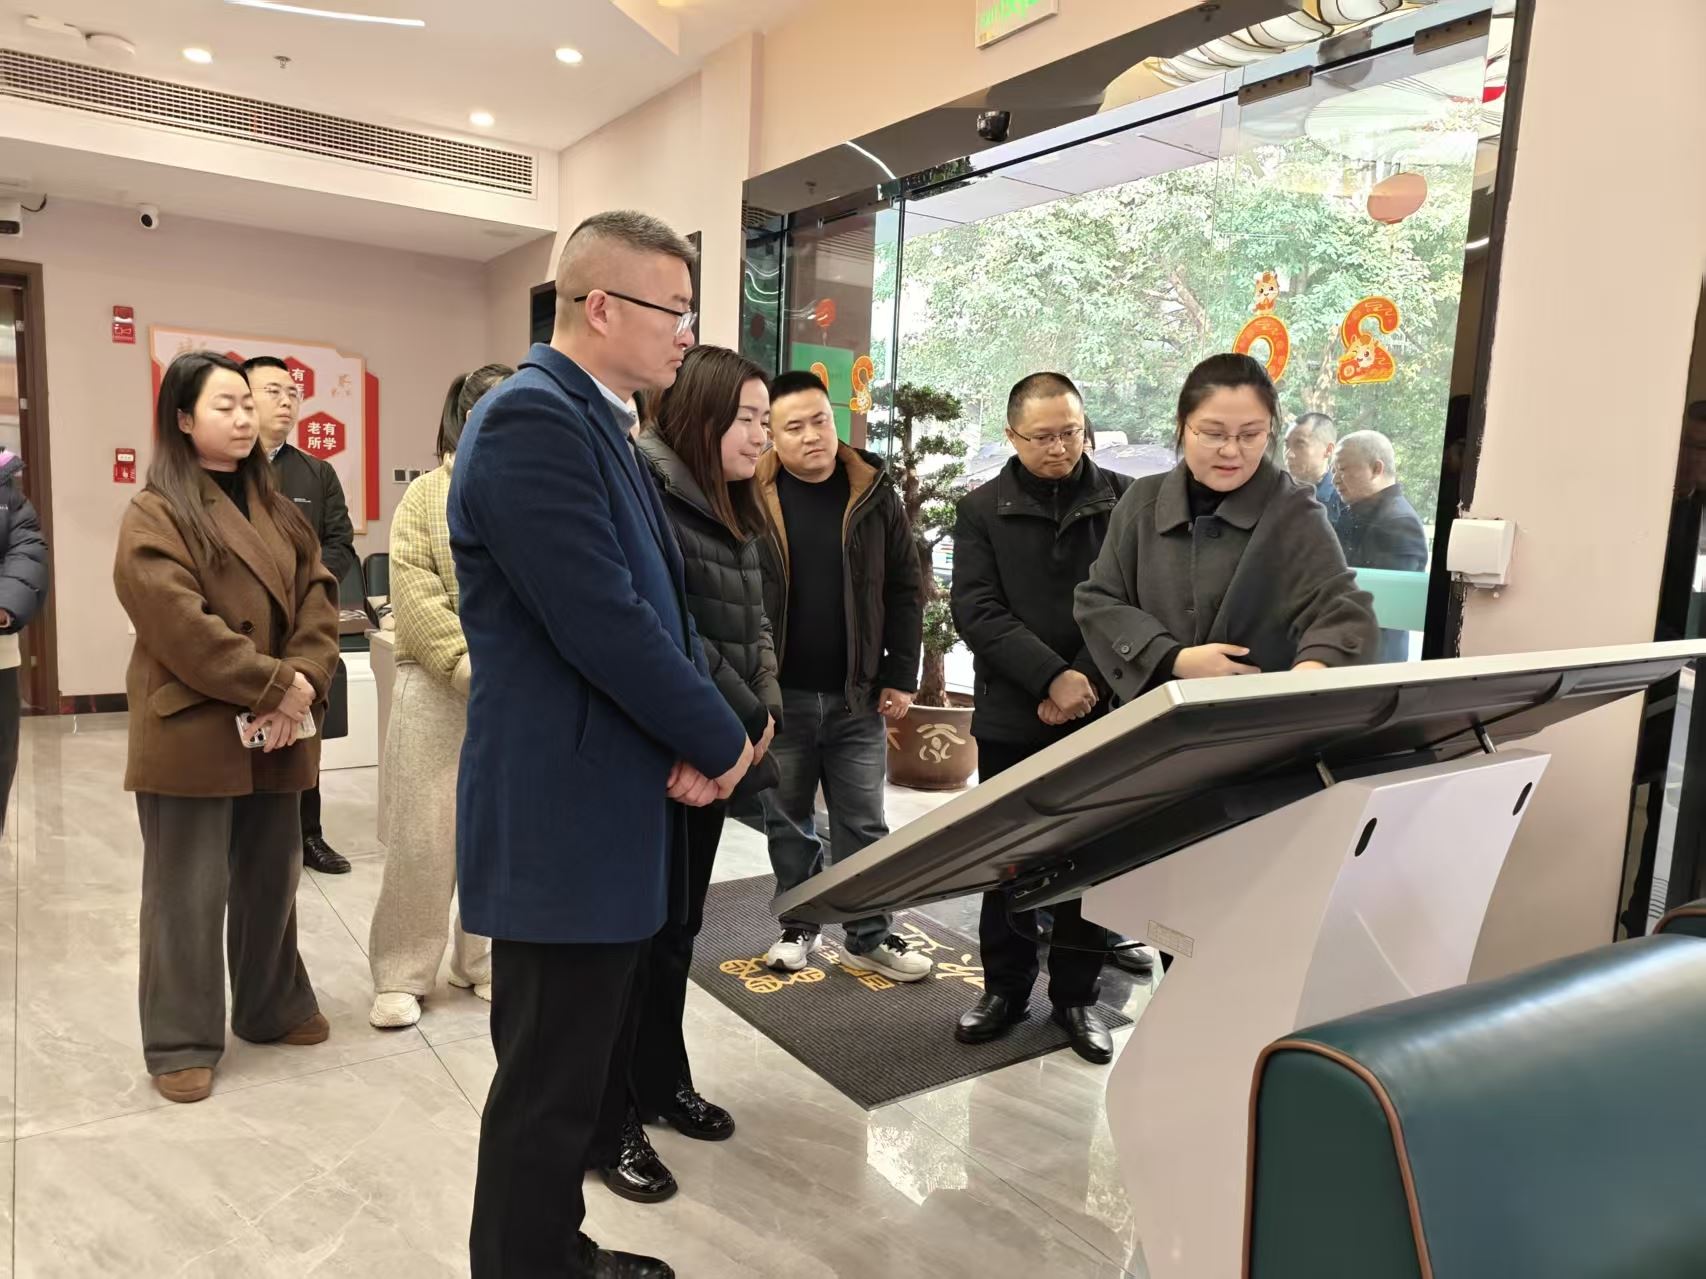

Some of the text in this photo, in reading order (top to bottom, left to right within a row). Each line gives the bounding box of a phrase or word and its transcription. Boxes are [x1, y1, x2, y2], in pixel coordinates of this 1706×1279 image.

[289, 368, 305, 381] 有
[307, 421, 336, 435] 老有
[307, 436, 337, 450] 所学
